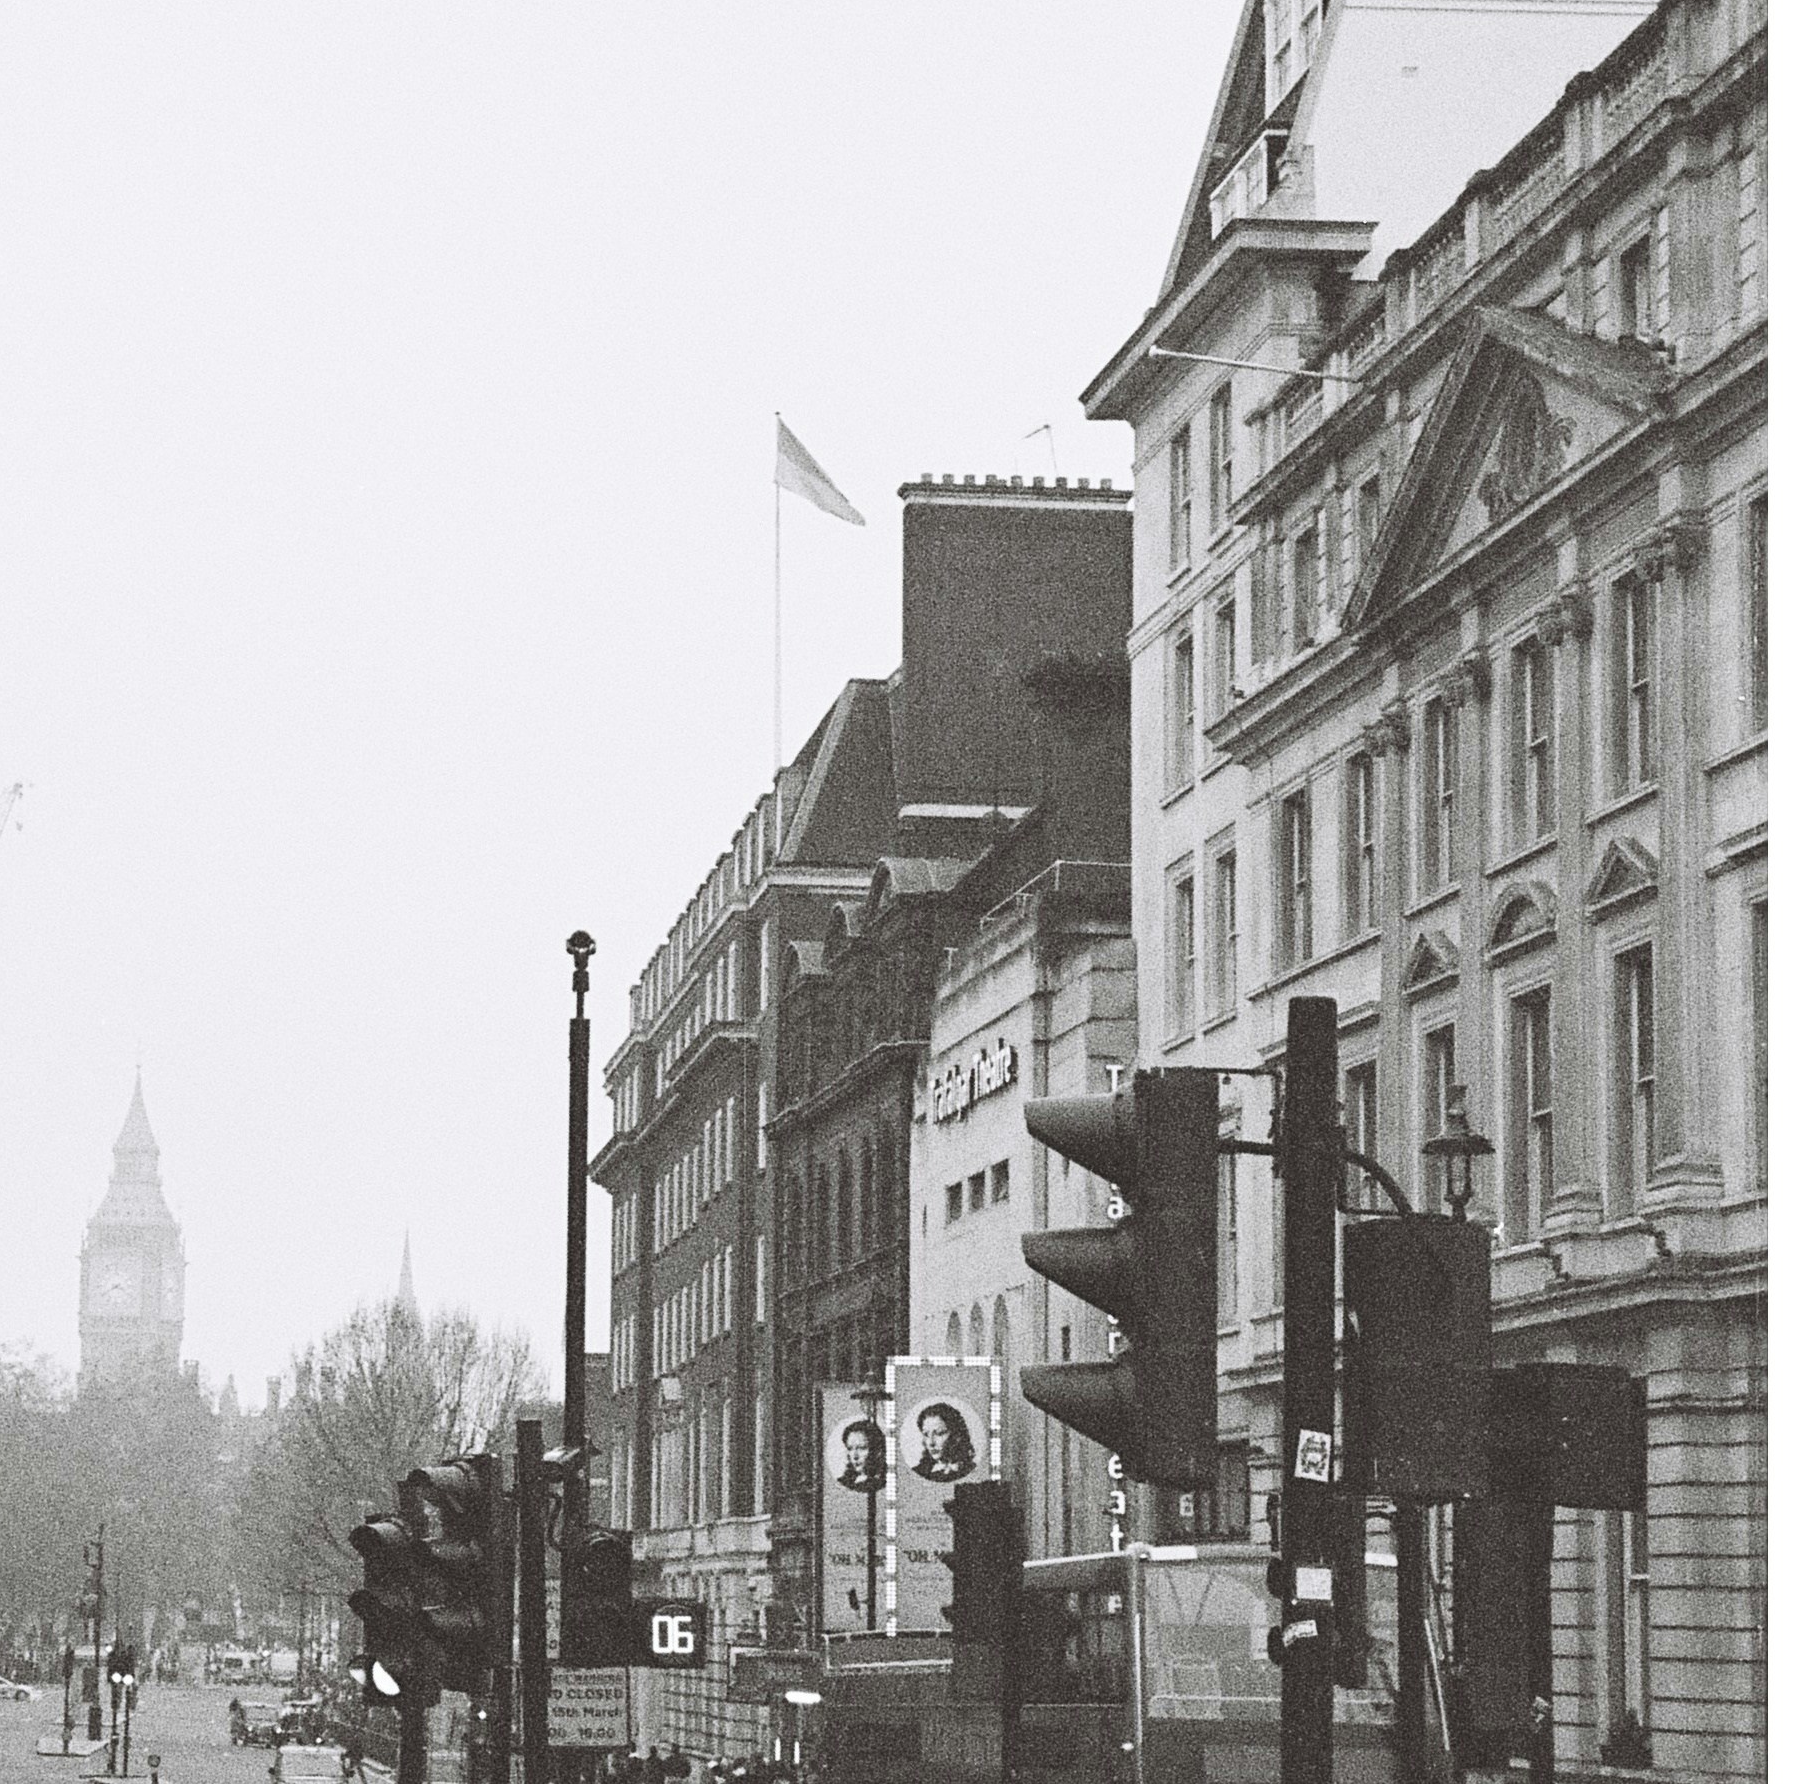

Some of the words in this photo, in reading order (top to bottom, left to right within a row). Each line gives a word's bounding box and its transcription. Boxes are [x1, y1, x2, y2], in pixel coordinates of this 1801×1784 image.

[972, 1038, 1012, 1101] Theatre
[652, 1615, 694, 1654] 06
[566, 1688, 623, 1700] CLOSED
